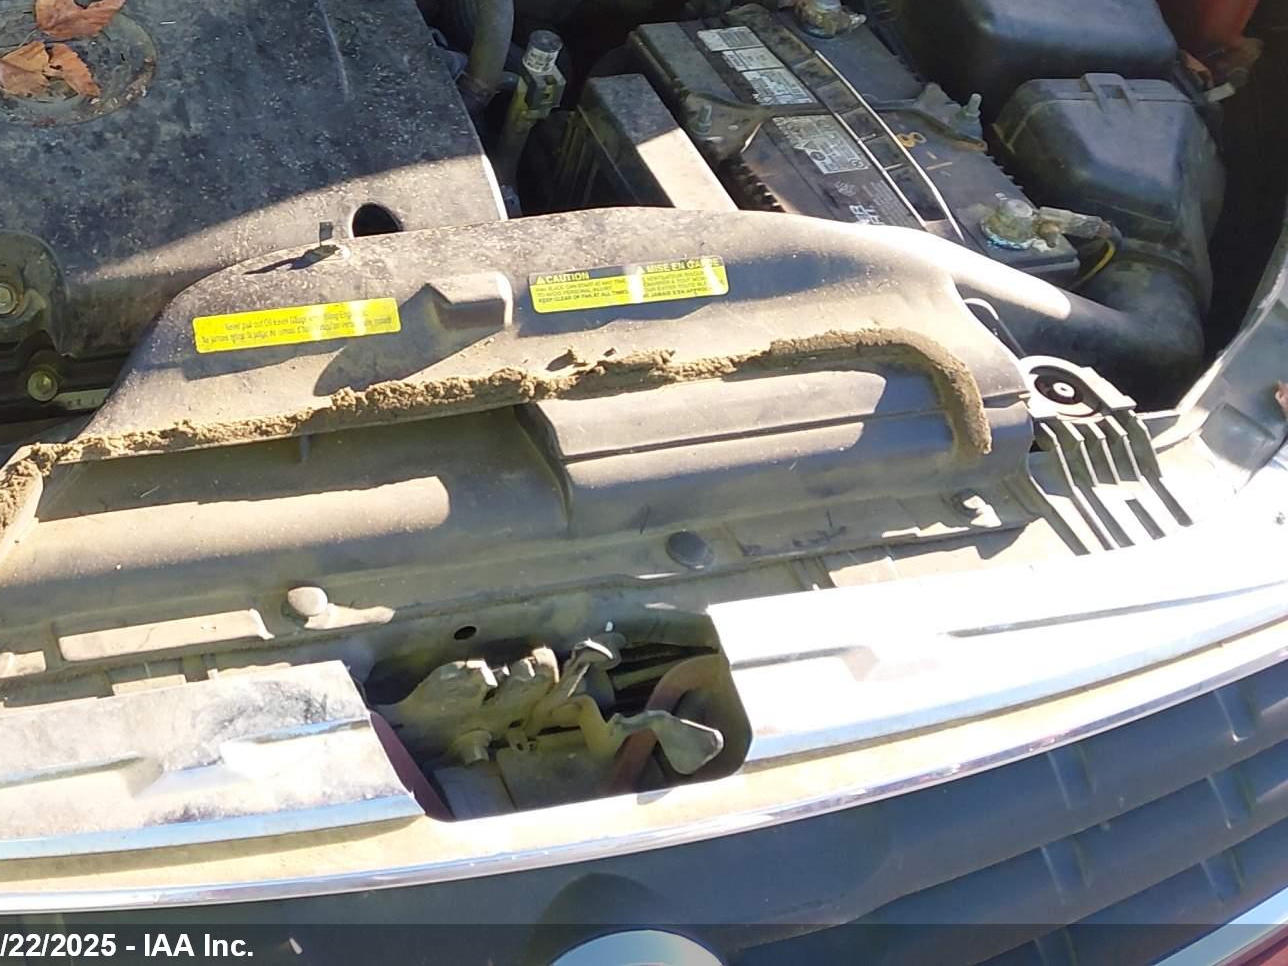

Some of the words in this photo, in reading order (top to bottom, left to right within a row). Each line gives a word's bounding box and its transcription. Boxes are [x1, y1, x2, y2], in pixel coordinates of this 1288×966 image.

[645, 262, 669, 272] MISE
[671, 261, 684, 270] EN
[547, 271, 589, 283] CAUTION
